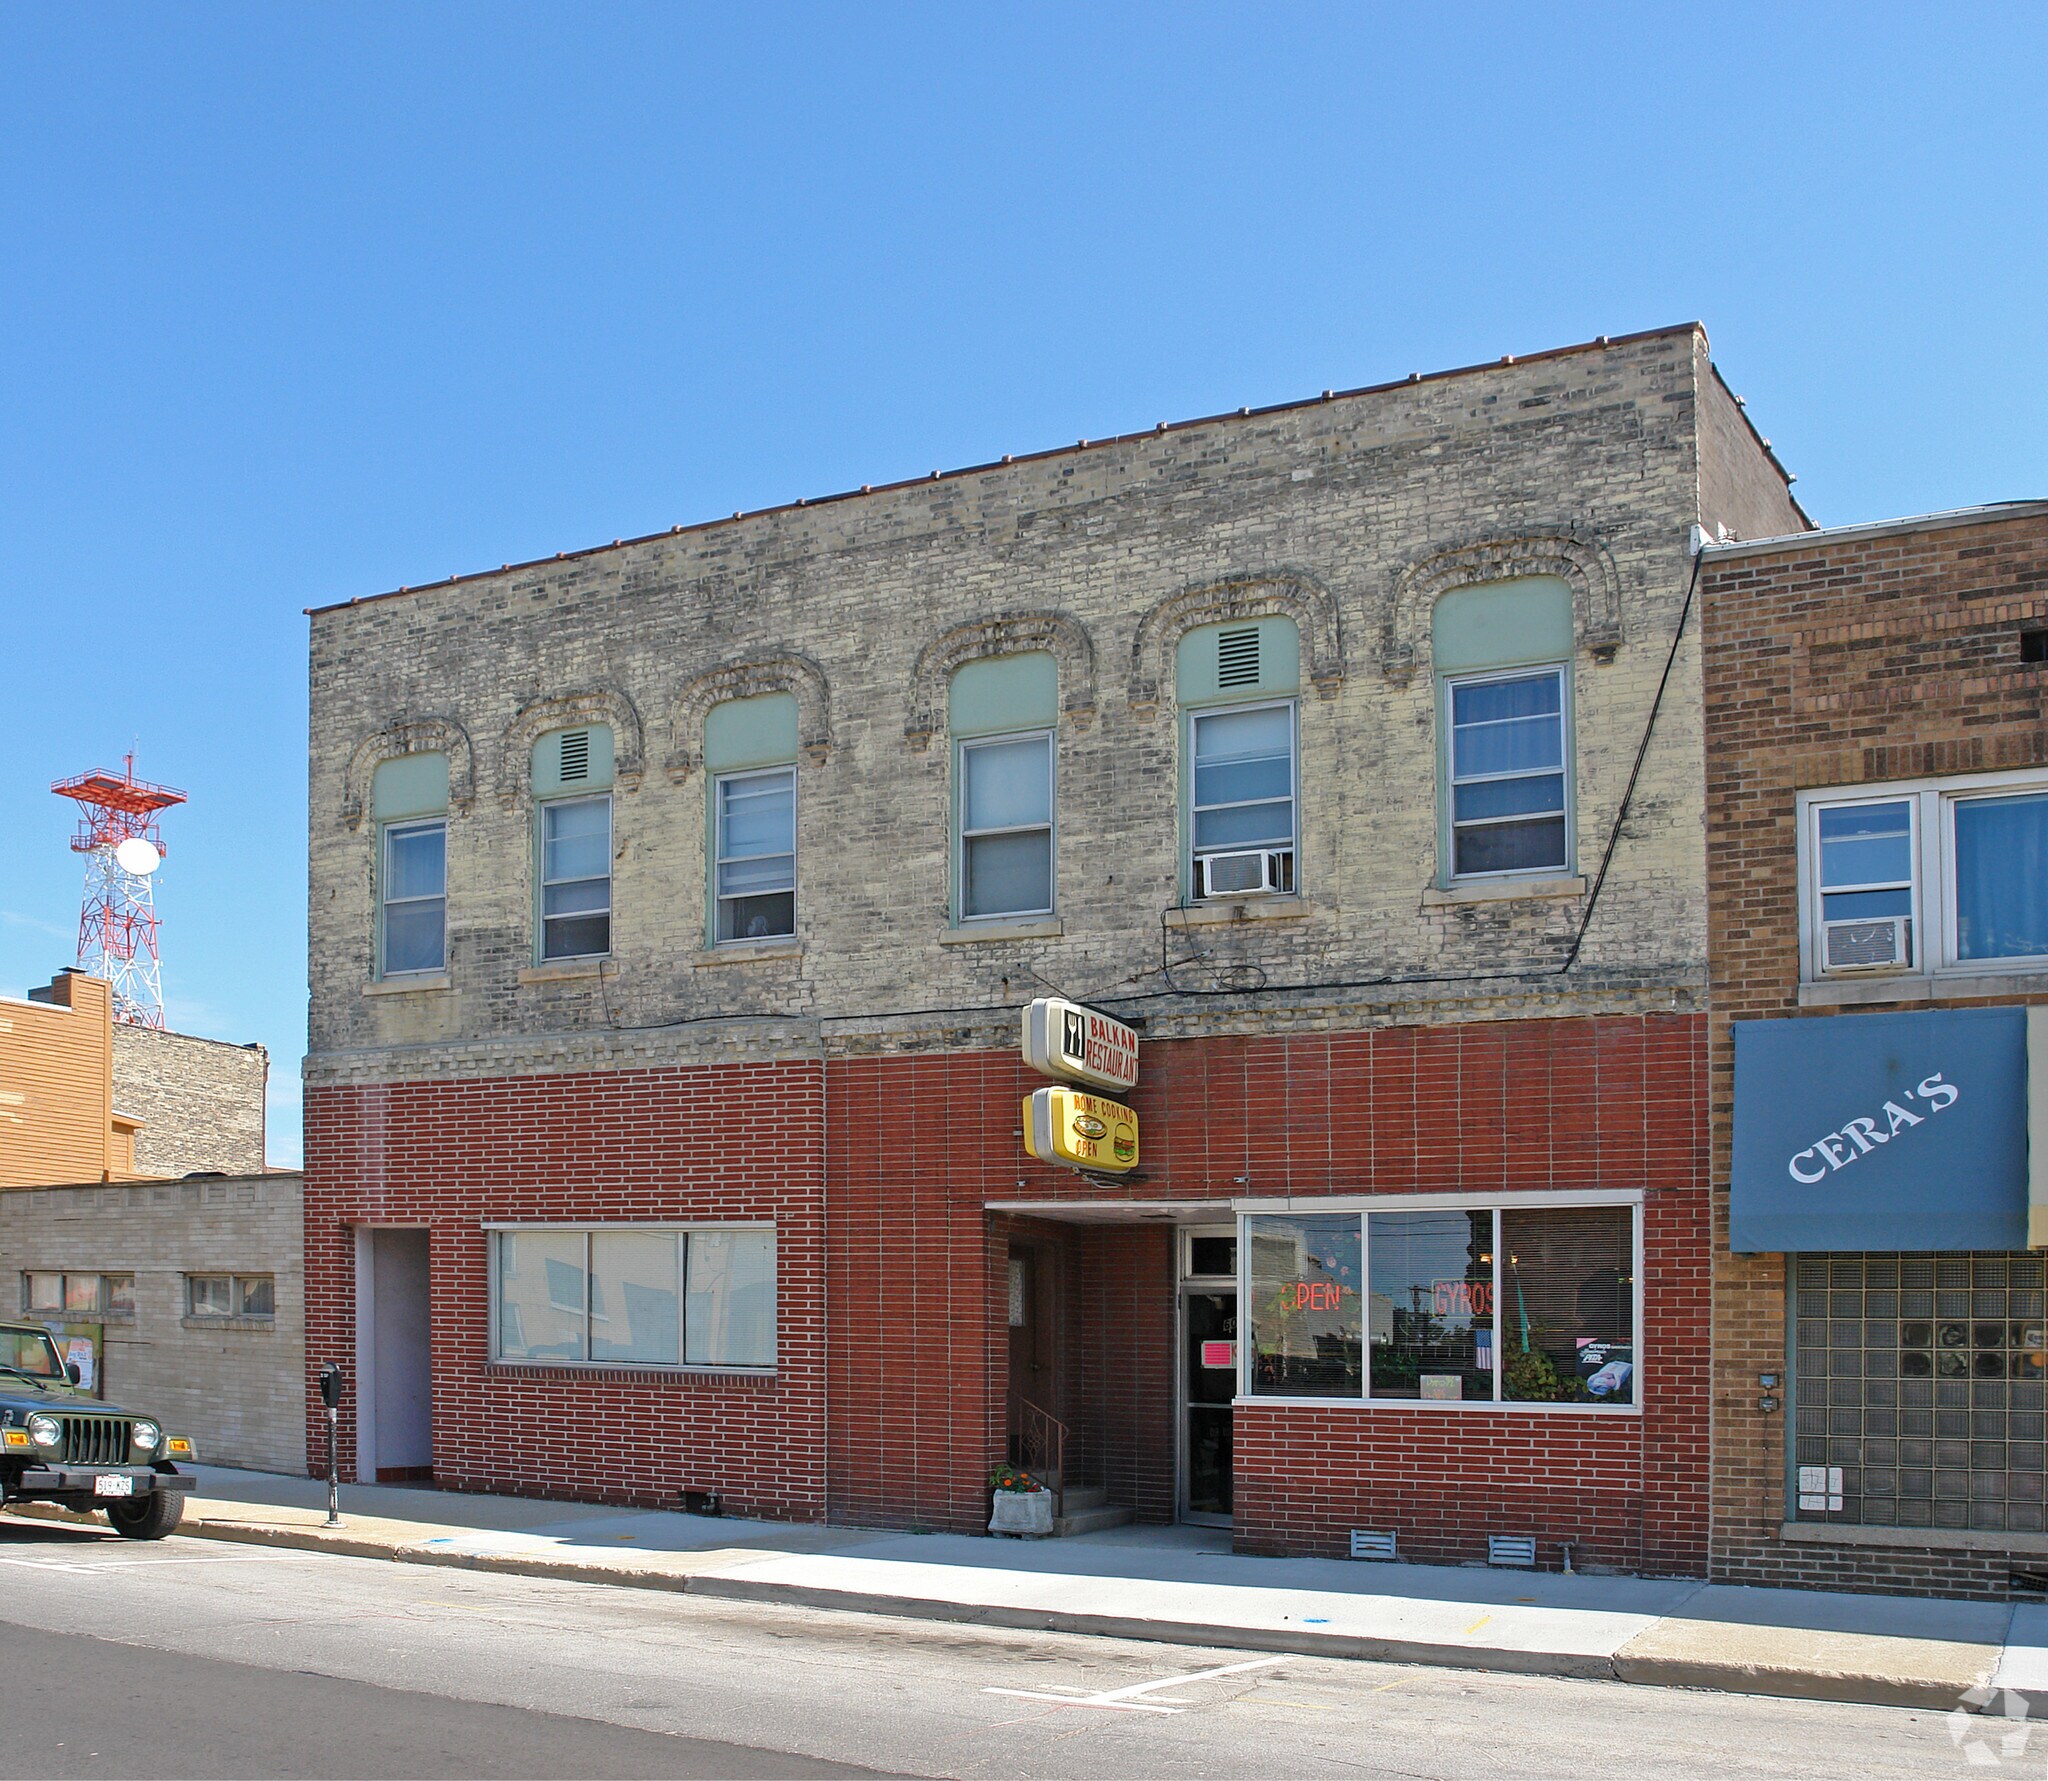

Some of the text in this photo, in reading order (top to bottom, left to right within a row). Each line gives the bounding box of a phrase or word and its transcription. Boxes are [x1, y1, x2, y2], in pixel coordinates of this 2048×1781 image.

[1090, 1016, 1135, 1053] BALKAN
[1085, 1038, 1139, 1085] RESTAURANT
[1073, 1094, 1134, 1124] HOME COOKING
[1788, 1071, 1959, 1184] CERA'S
[1076, 1139, 1098, 1158] OPEN
[1435, 1281, 1494, 1315] GYROS
